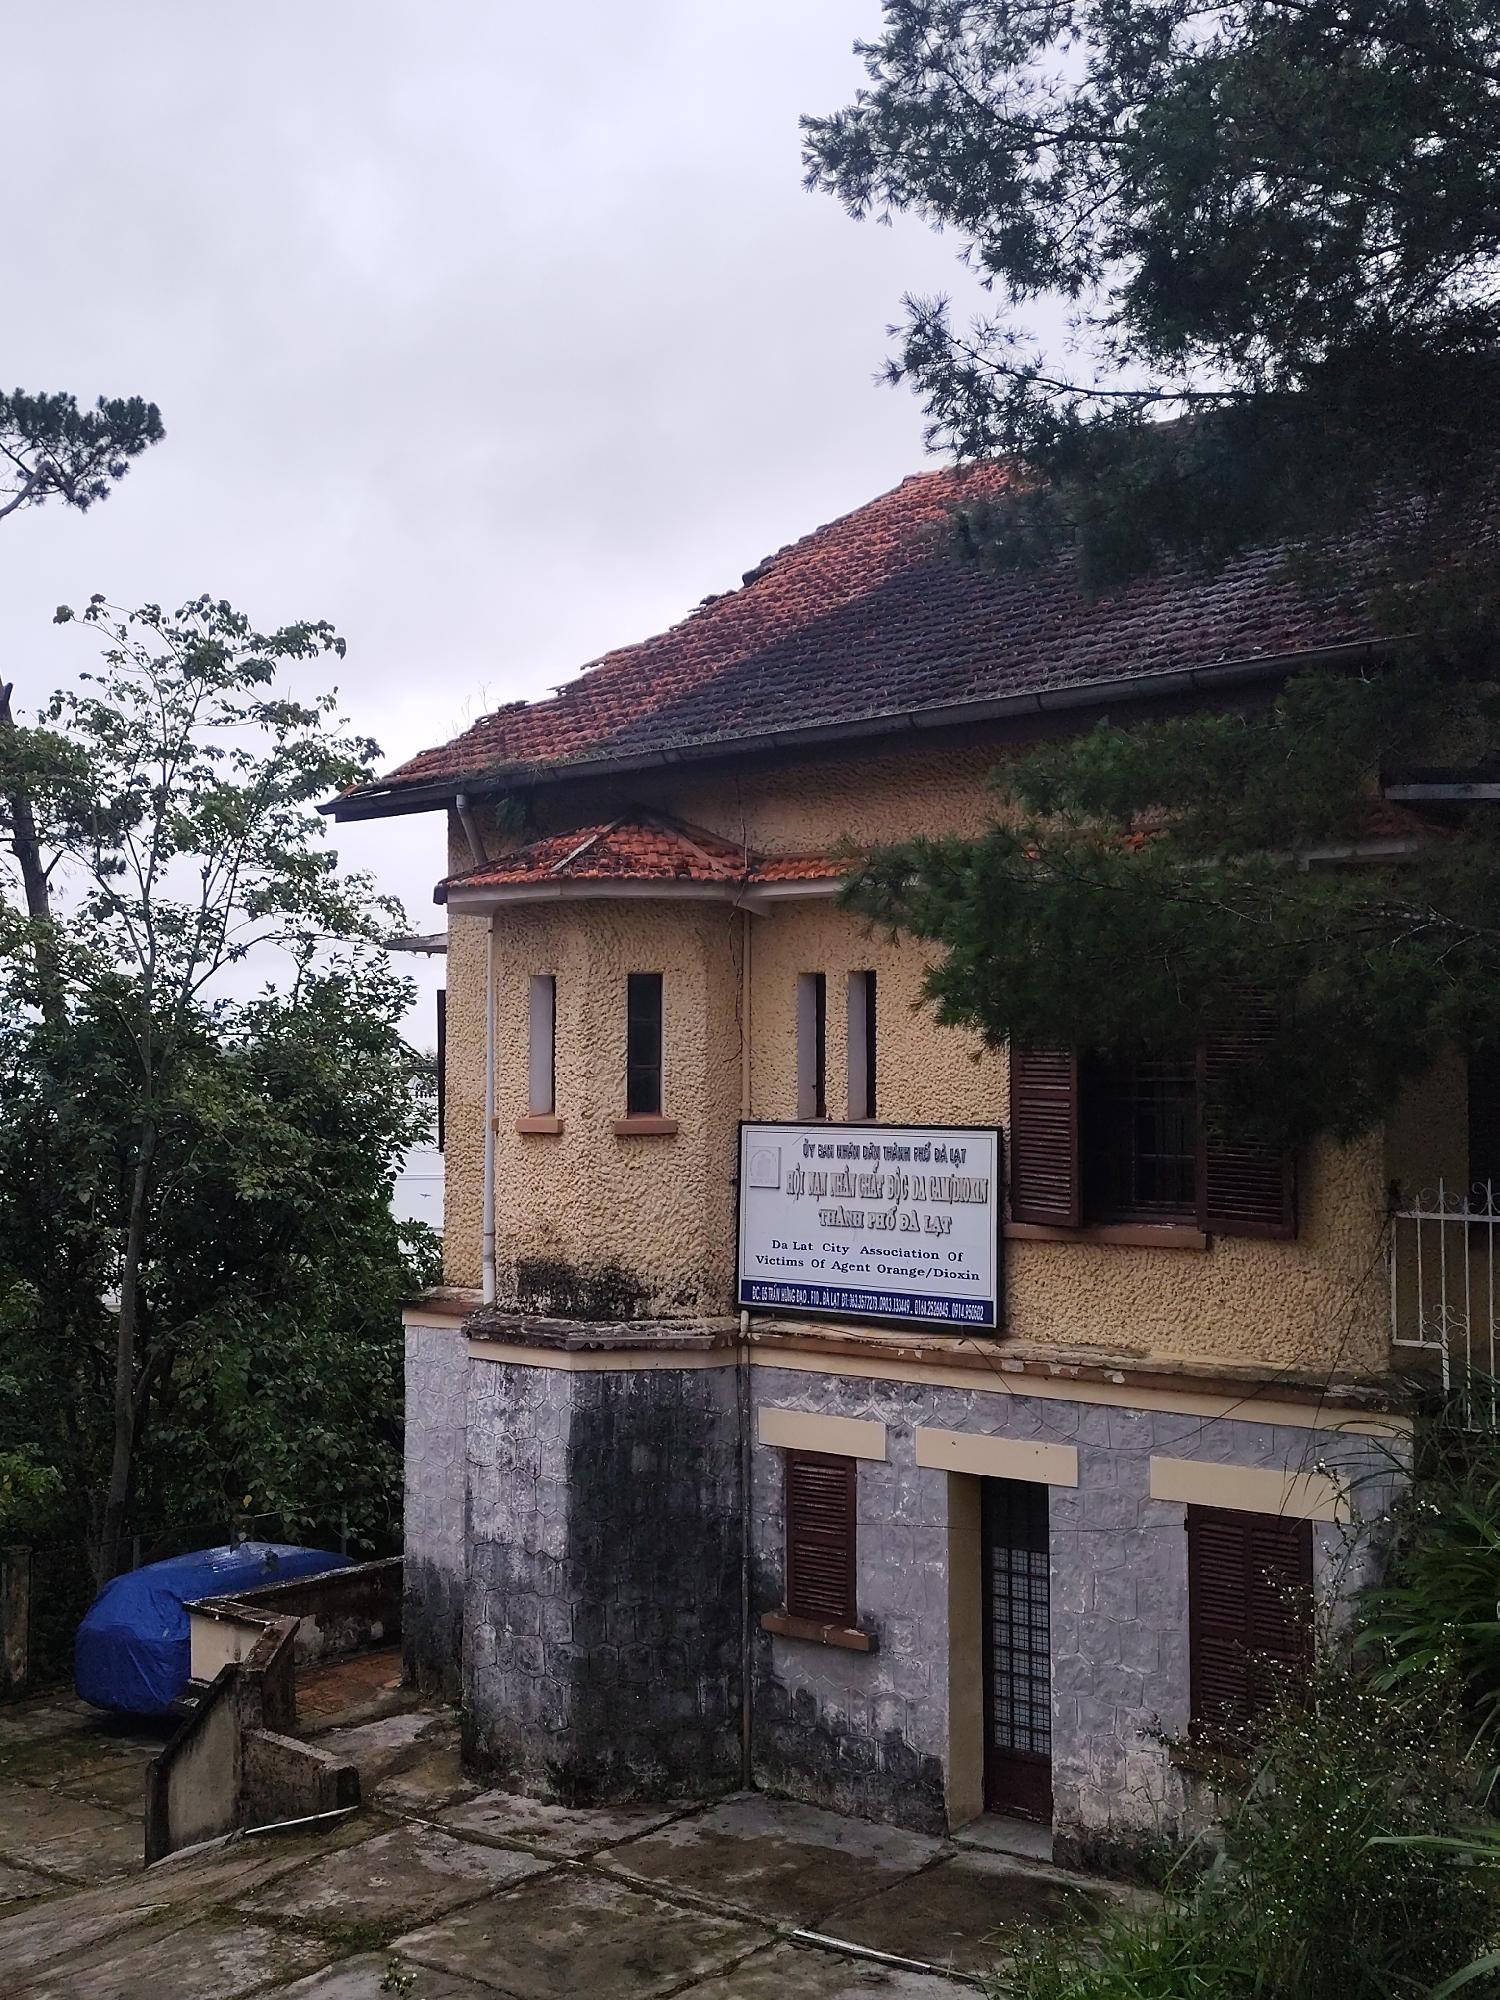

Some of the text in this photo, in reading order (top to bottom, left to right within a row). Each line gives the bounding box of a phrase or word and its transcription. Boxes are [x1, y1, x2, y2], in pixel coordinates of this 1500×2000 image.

[818, 1143, 834, 1159] BAN
[837, 1141, 860, 1160] NHÂN
[863, 1142, 880, 1160] DÂN
[883, 1142, 911, 1162] THÀNH
[913, 1141, 931, 1162] PHỐ
[934, 1143, 948, 1163] ĐÀ
[950, 1148, 966, 1168] LẠT
[786, 1162, 805, 1200] HỘI
[808, 1171, 827, 1202] NẠN
[830, 1164, 857, 1198] NHÂN
[858, 1161, 884, 1199] CHẤT
[887, 1166, 908, 1205] ĐỘC
[911, 1175, 927, 1201] DA
[818, 1205, 952, 1237] THÀNH PHỐ ĐÀ LẠT
[772, 1239, 965, 1262] Da Lat City Association Of
[755, 1255, 980, 1281] Victims Of Agent Orange/Dioxin
